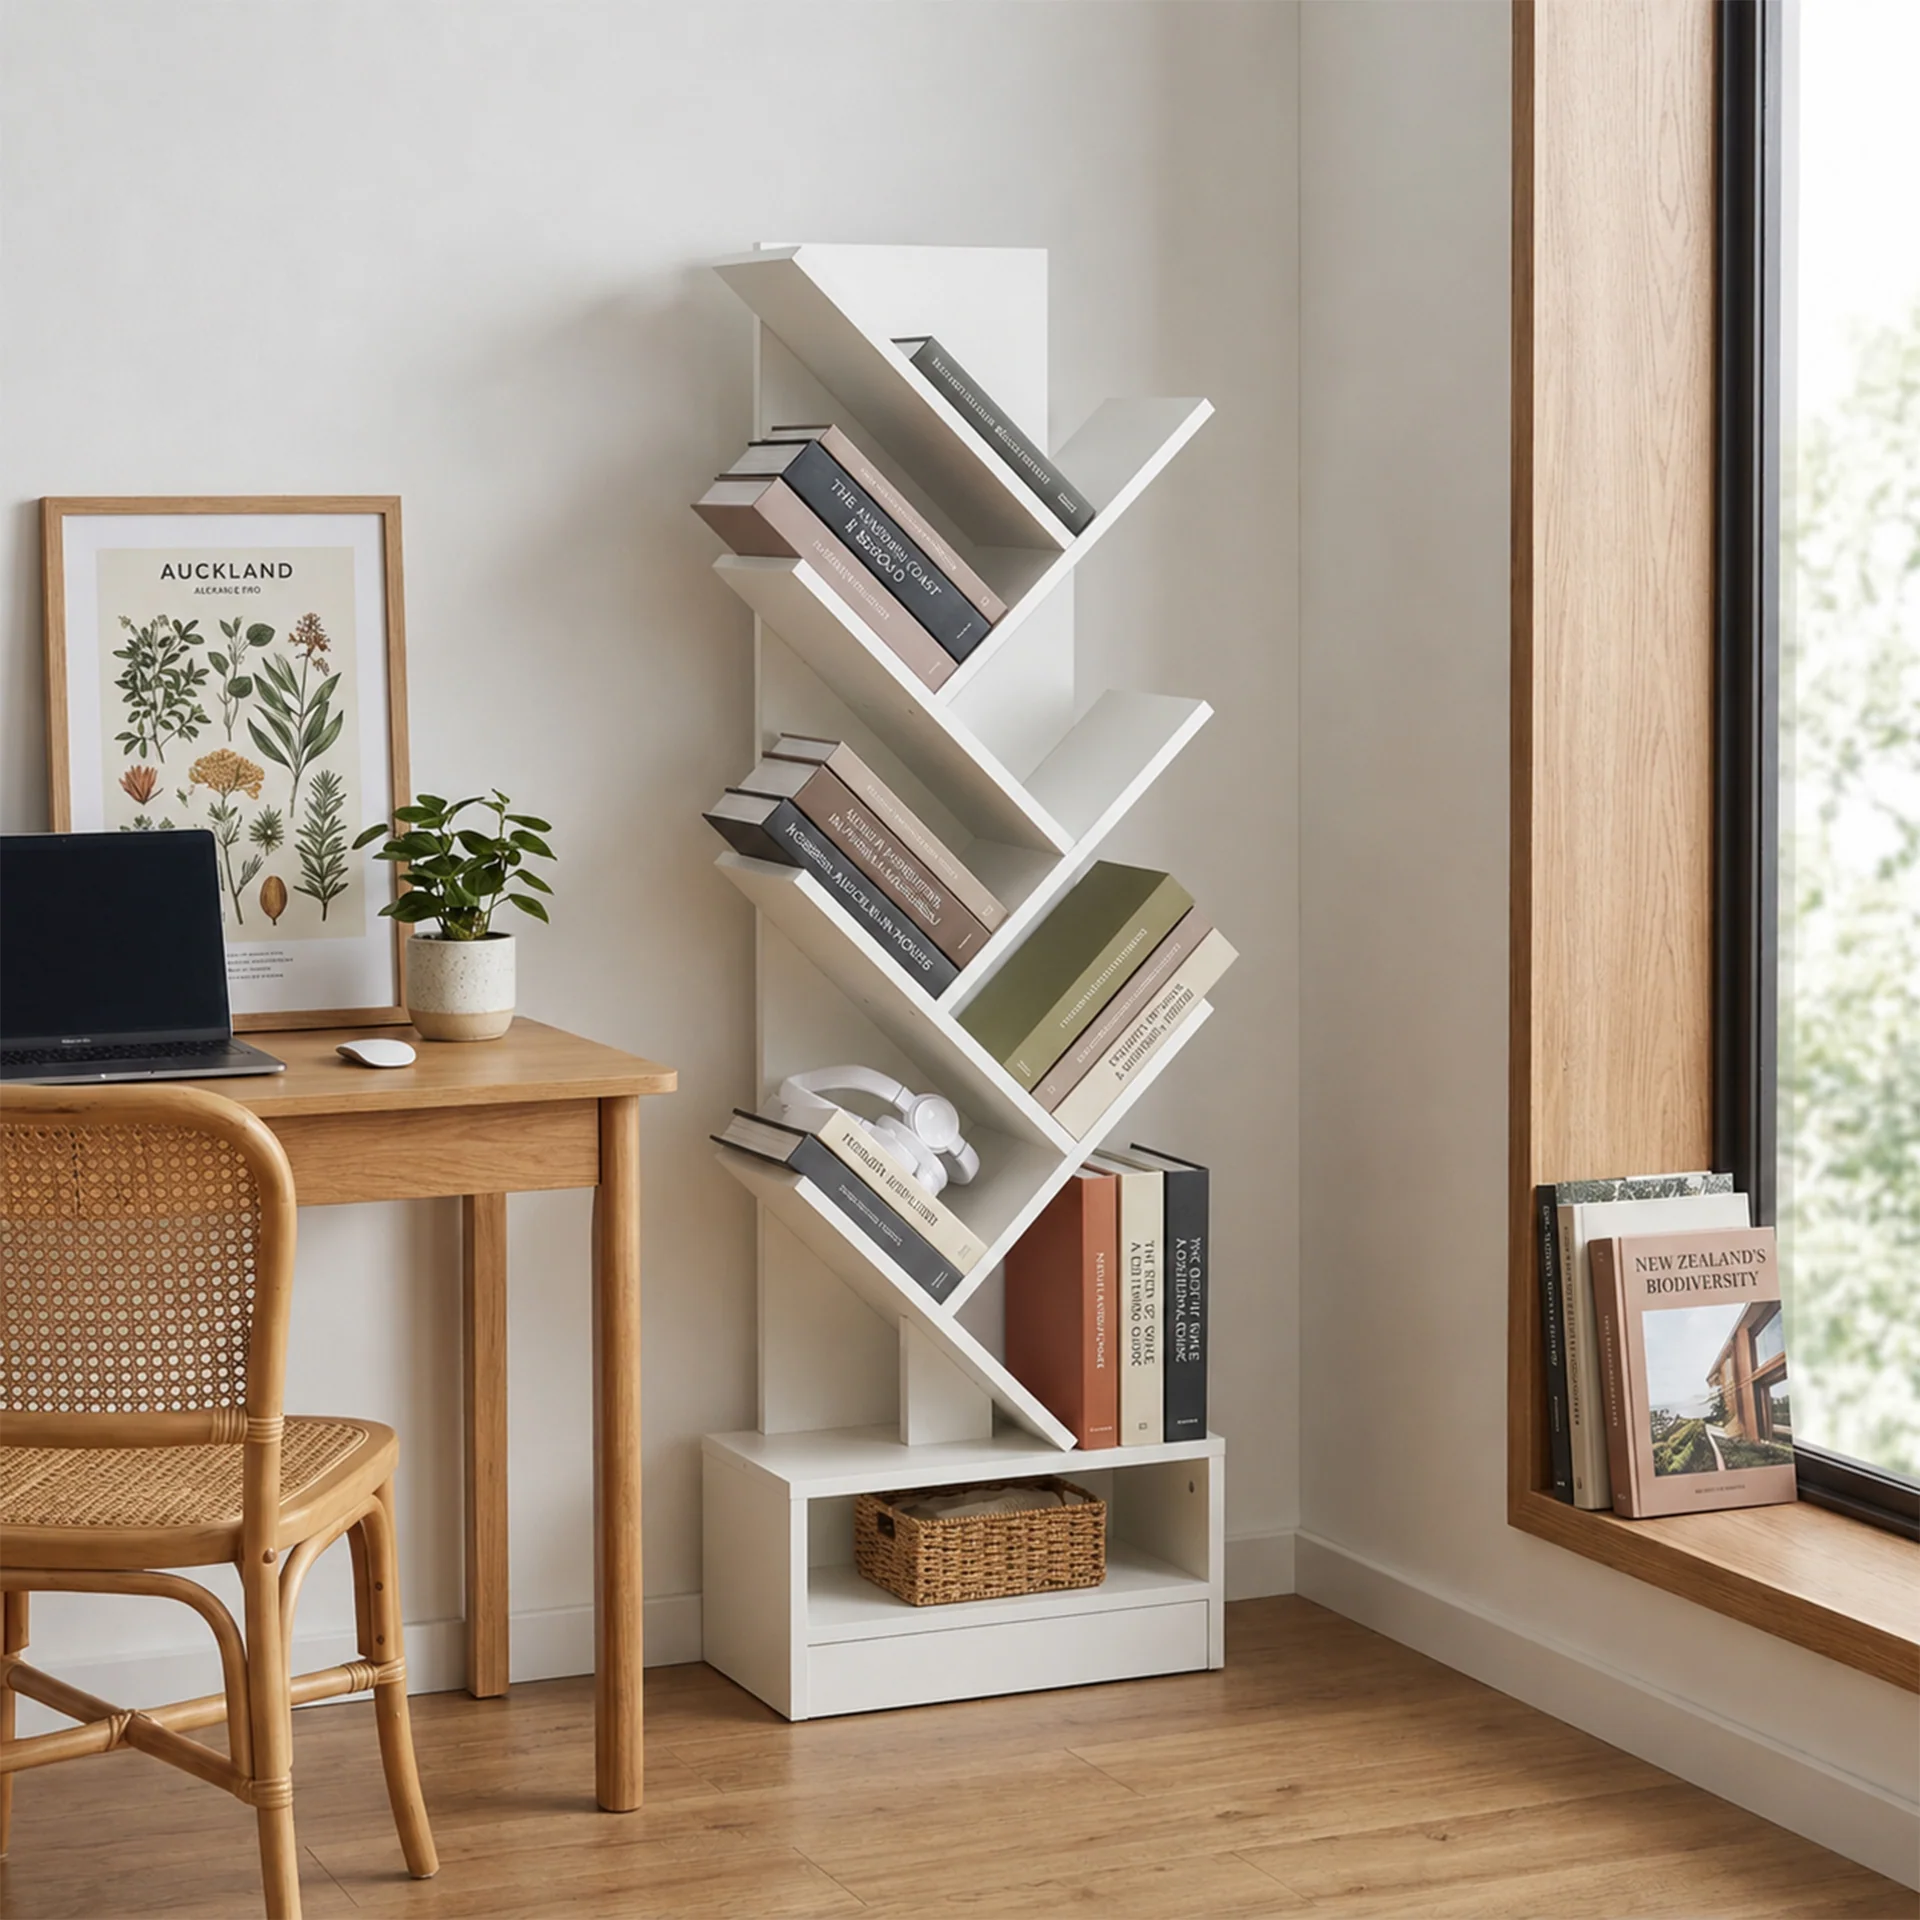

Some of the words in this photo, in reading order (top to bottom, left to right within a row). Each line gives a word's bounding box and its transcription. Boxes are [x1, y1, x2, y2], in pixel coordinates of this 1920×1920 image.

[831, 478, 858, 509] THE
[160, 562, 293, 580] AUCKLAND
[1635, 1255, 1672, 1272] NEW
[1677, 1248, 1767, 1270] ZEALAND'S
[1646, 1270, 1759, 1294] BIODIVERSITY
